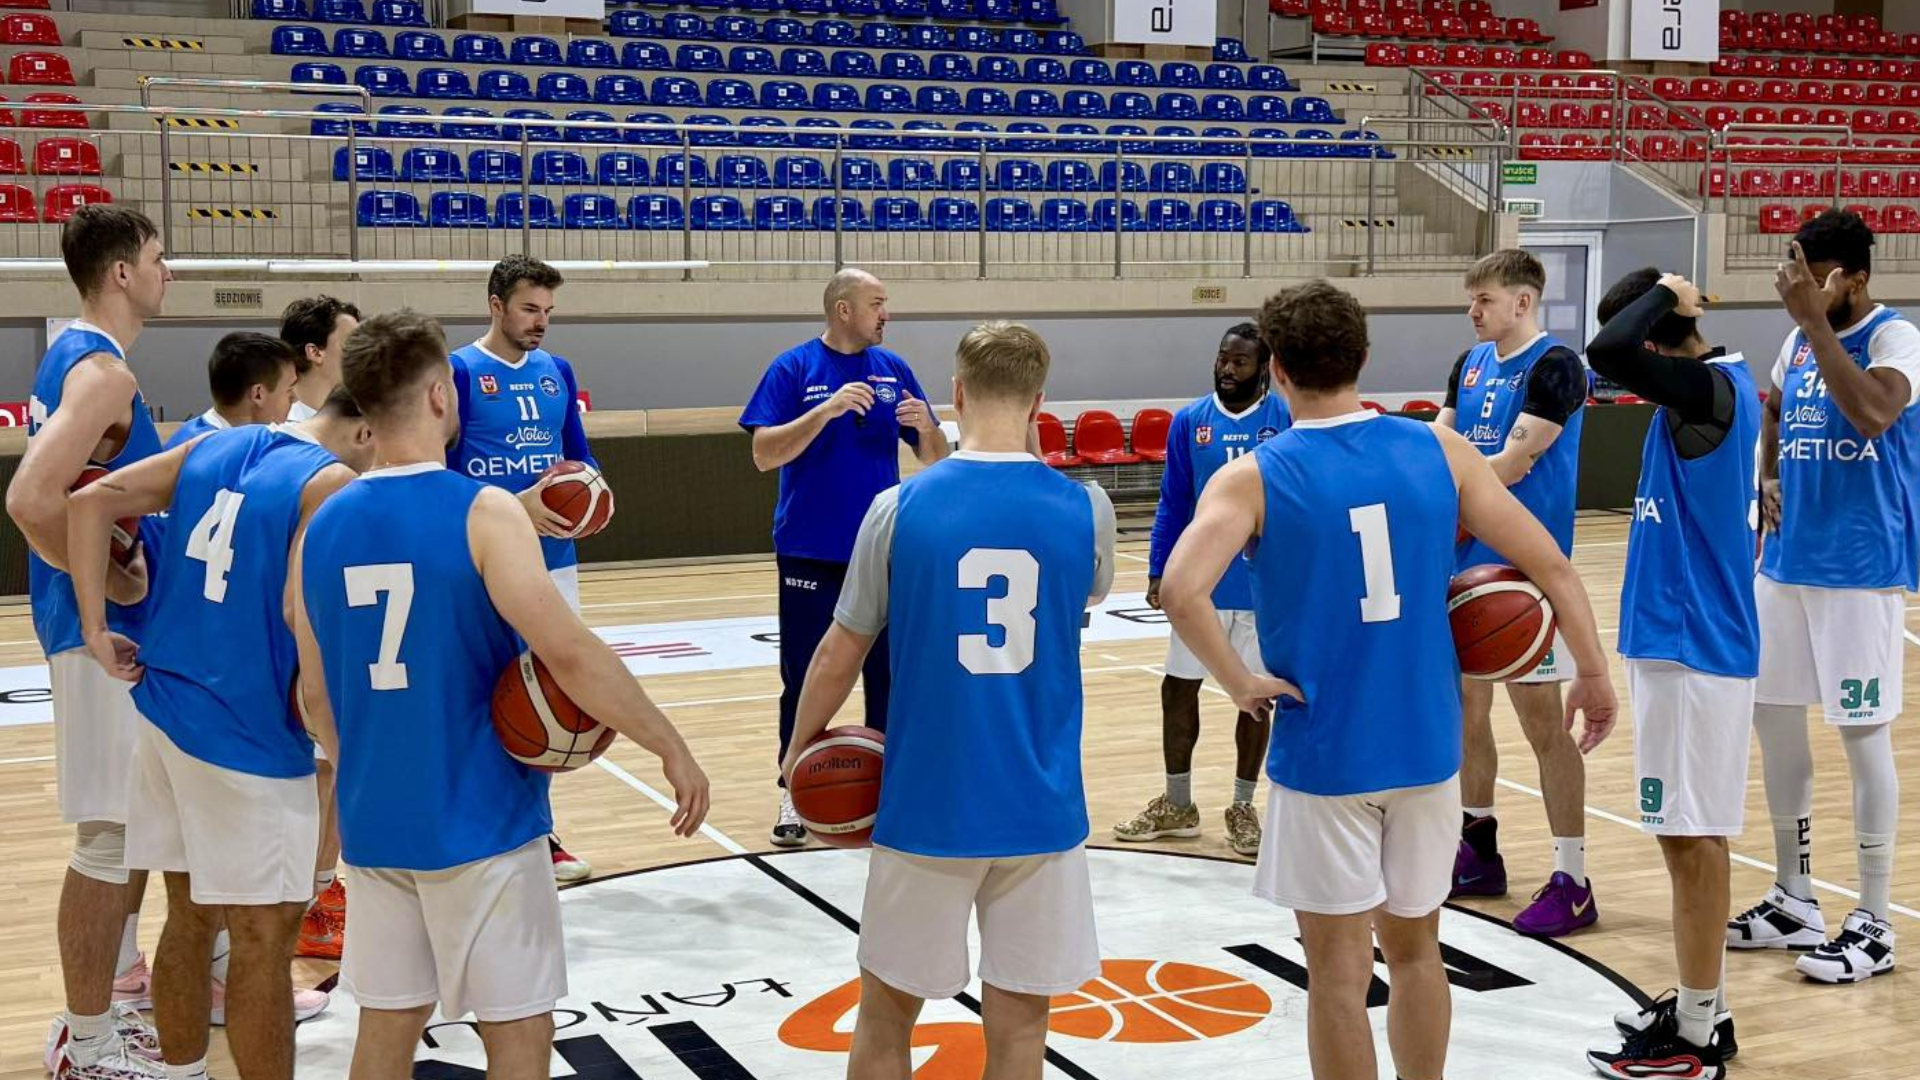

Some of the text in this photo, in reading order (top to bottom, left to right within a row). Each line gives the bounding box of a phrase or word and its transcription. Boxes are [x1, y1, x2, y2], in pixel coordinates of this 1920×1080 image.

[516, 396, 540, 421] 11
[1222, 433, 1250, 441] BESTO
[185, 488, 246, 603] 4
[1349, 502, 1402, 622] 1
[343, 562, 414, 690] 7
[958, 548, 1040, 675] 3
[1840, 677, 1881, 710] 34
[1847, 710, 1874, 719] BESTO
[809, 756, 861, 775] molten
[1640, 777, 1663, 813] 9
[1640, 815, 1665, 825] ESTO
[1858, 921, 1886, 939] NIKE
